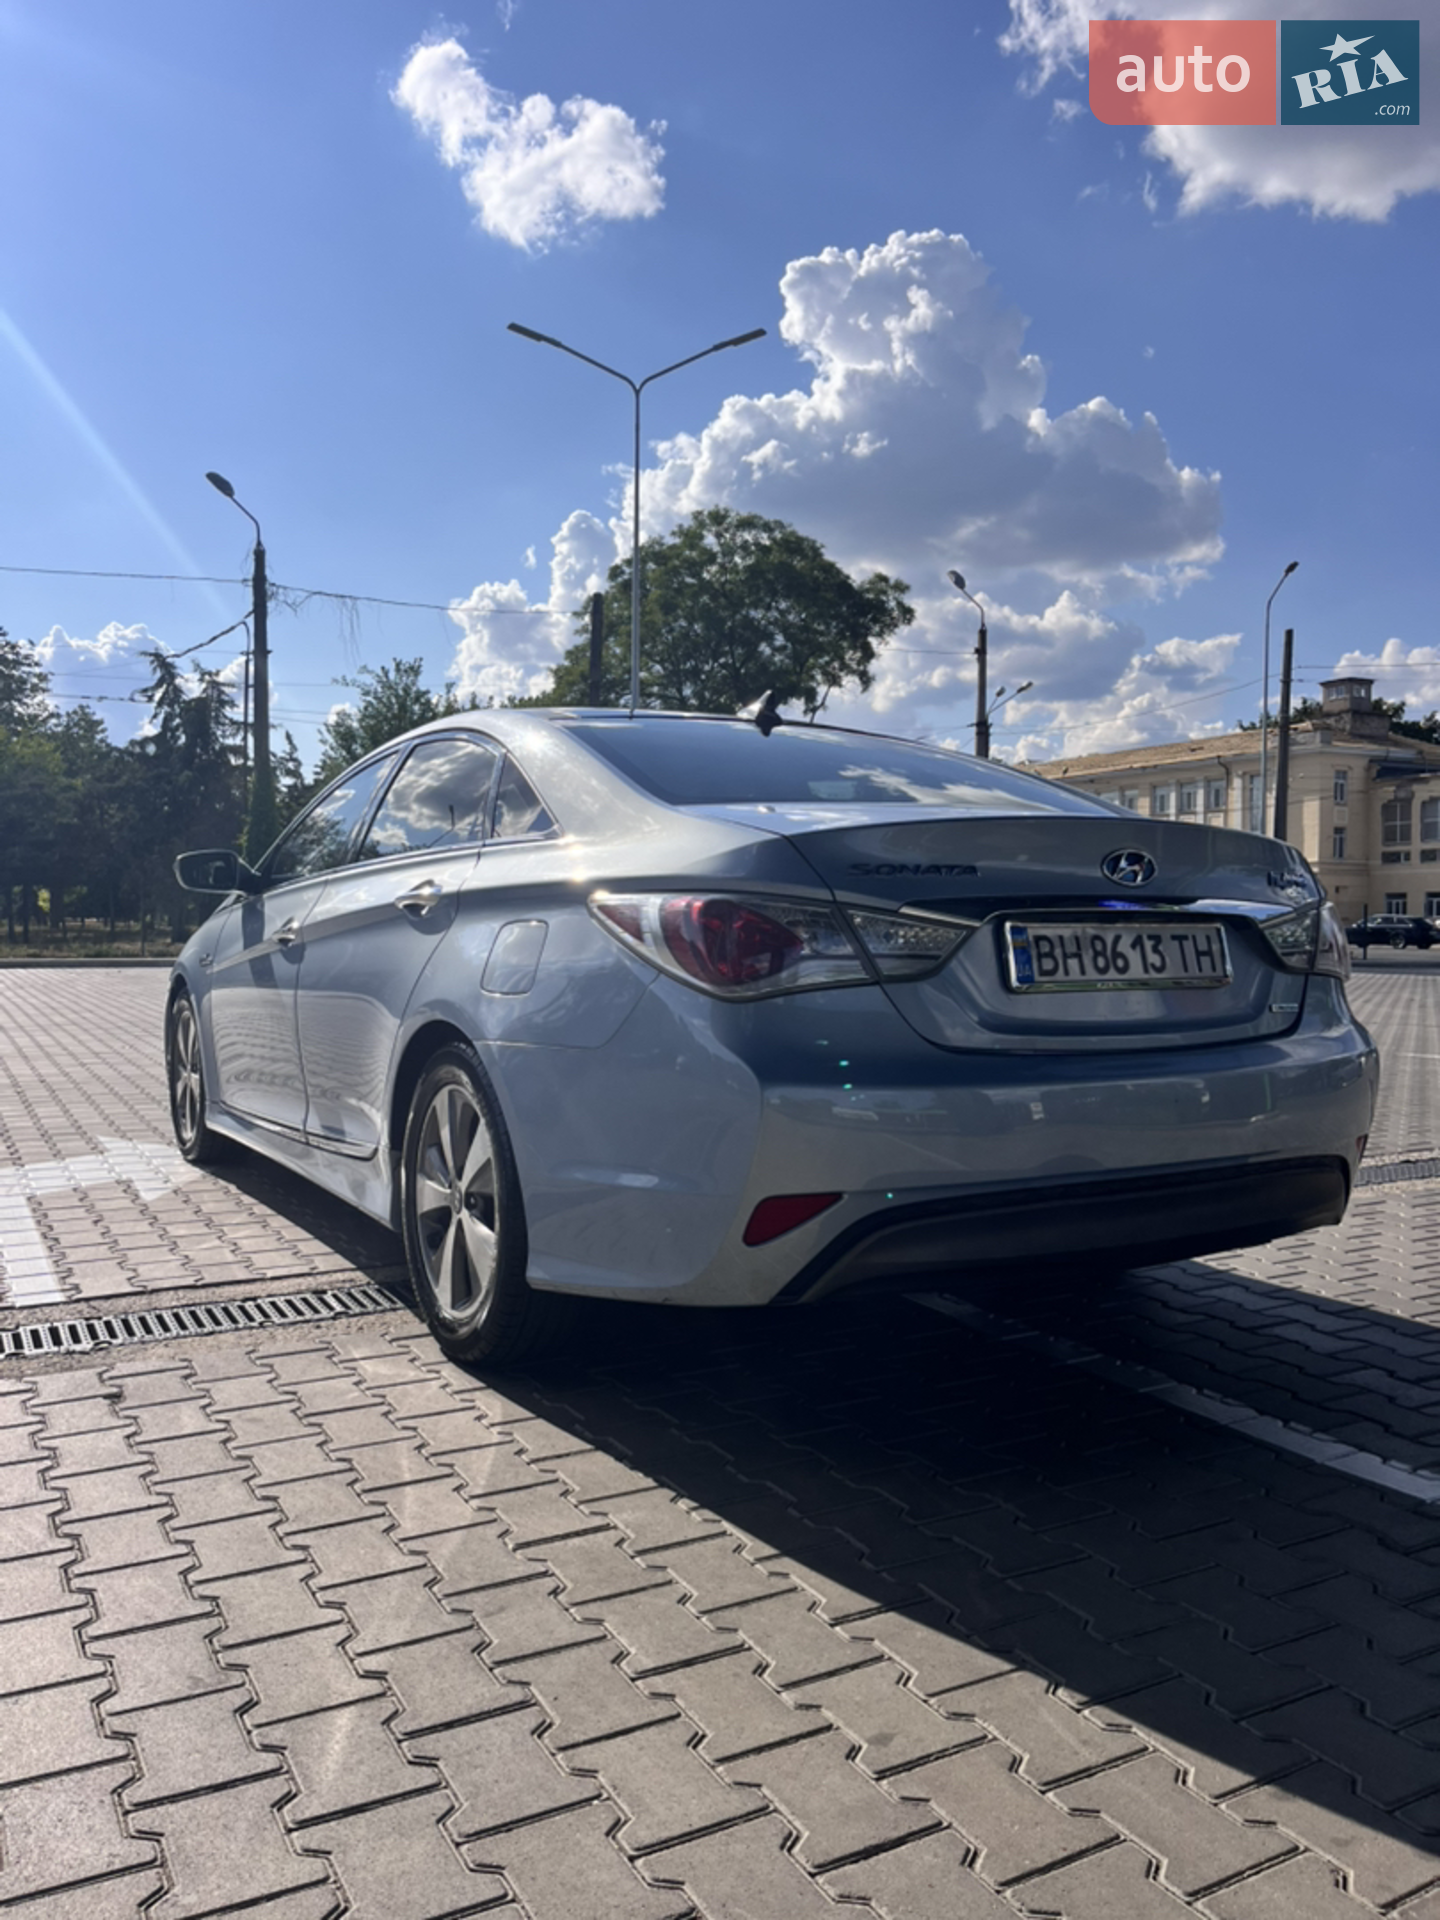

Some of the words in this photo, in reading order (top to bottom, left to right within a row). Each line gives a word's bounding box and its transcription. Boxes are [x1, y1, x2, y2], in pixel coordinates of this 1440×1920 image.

[848, 863, 978, 876] SONATA
[1032, 935, 1087, 977] BH
[1090, 934, 1167, 975] 8613
[1171, 934, 1218, 974] TH
